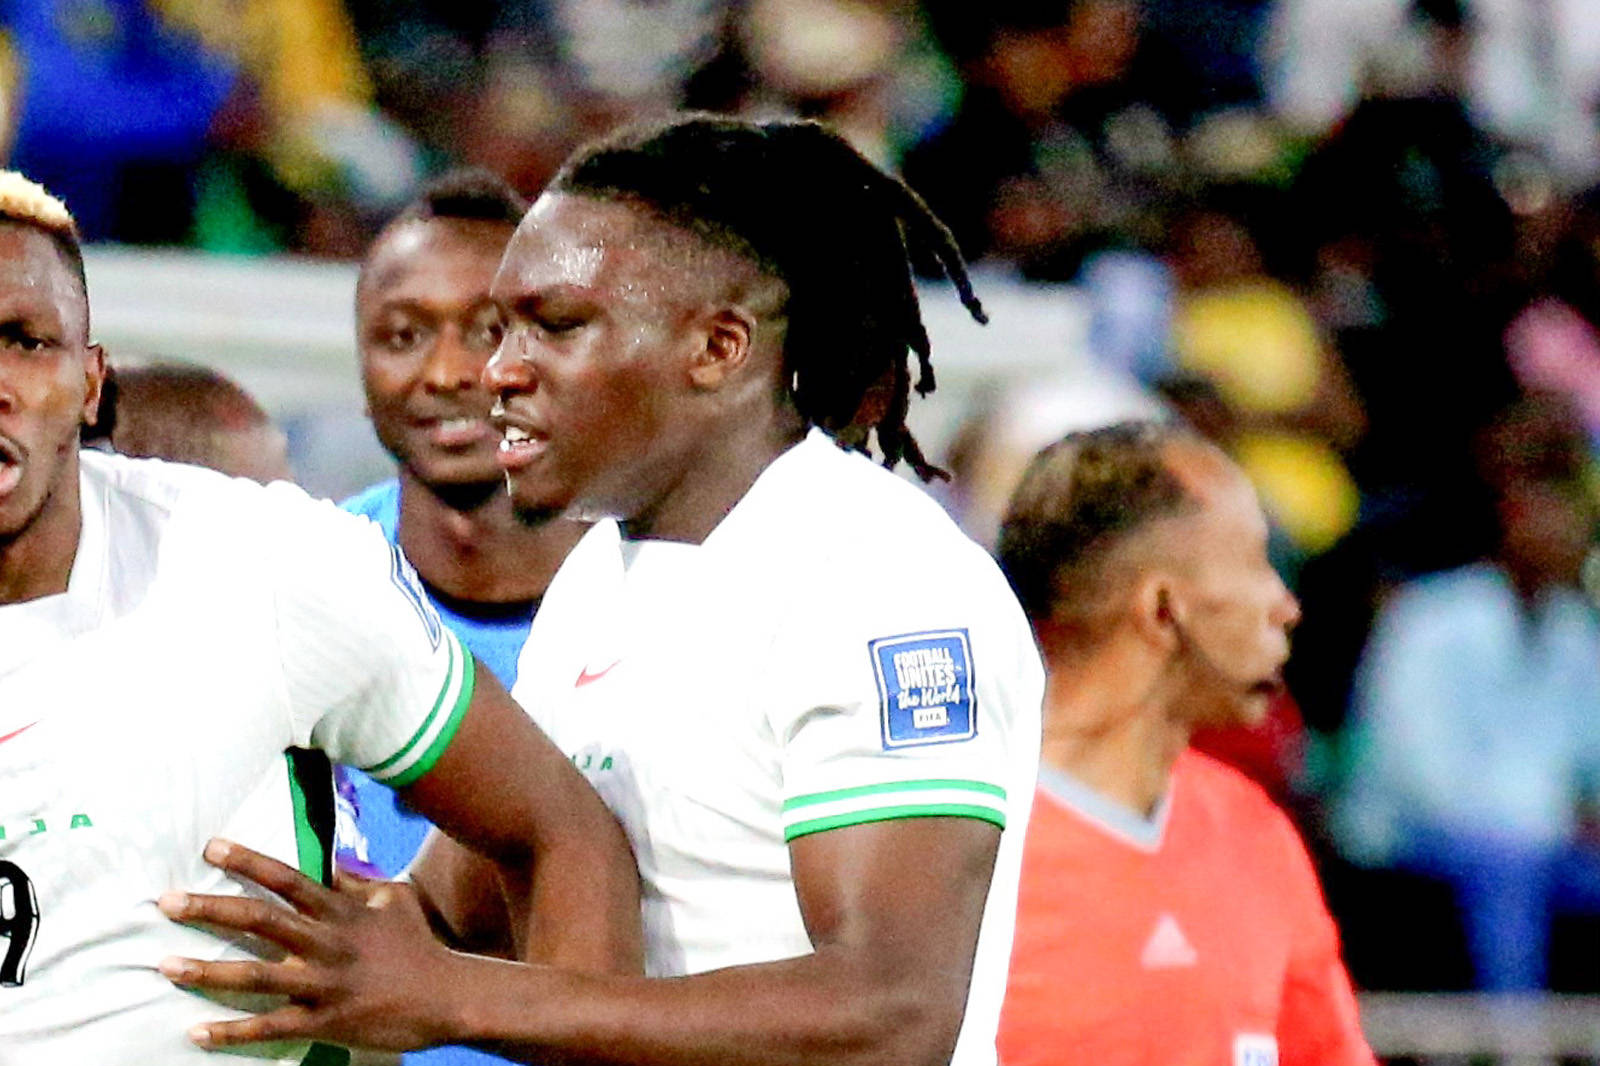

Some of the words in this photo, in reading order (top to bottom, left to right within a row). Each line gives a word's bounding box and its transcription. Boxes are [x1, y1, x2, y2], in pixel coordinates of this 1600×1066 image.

[897, 661, 956, 690] UNITES
[921, 684, 960, 706] World
[919, 713, 942, 722] FIFA
